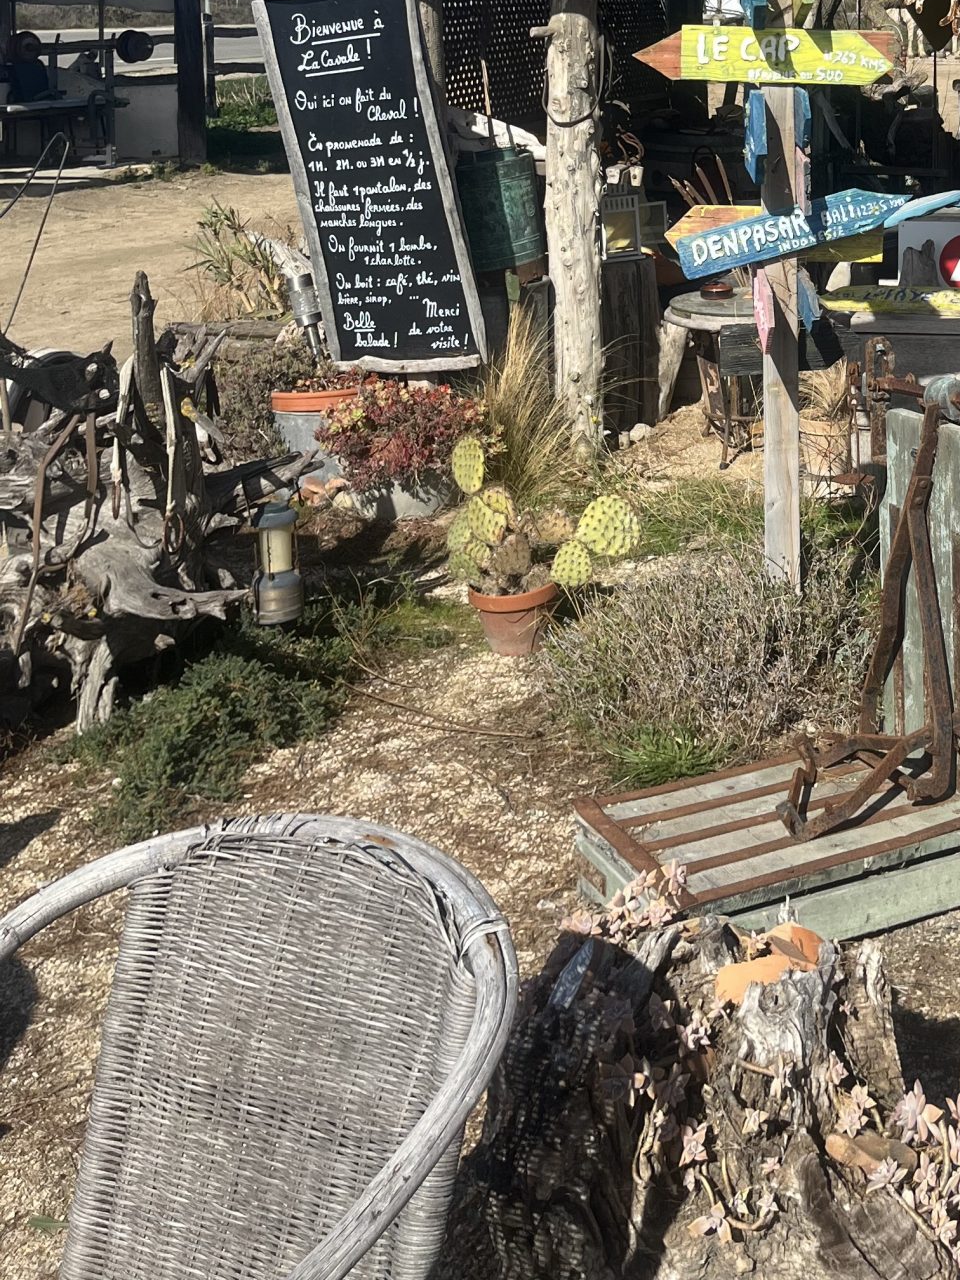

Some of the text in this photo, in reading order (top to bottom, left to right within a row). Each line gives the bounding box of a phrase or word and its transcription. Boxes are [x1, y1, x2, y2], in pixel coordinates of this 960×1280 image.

[290, 10, 384, 44] Bienvenue à
[298, 50, 320, 71] La
[321, 44, 360, 67] Cavale
[697, 31, 800, 65] LE CAP
[816, 68, 844, 81] SUD
[295, 87, 391, 112] Oui ici on fait du
[367, 99, 407, 121] Cheval
[308, 132, 323, 151] En
[326, 133, 383, 157] promenade
[389, 131, 403, 144] de
[356, 160, 367, 168] ou
[389, 157, 401, 165] en
[314, 181, 325, 197] Il
[329, 181, 349, 206] faut
[414, 178, 431, 191] des
[315, 199, 360, 212] chaussures
[406, 197, 423, 210] des
[321, 213, 356, 227] manches
[328, 235, 345, 252] On
[349, 237, 384, 261] fournit
[691, 208, 810, 266] DENPASAR
[336, 273, 351, 289] On
[354, 273, 373, 288] boit
[385, 273, 412, 295] café,
[416, 271, 438, 285] thé,
[423, 298, 460, 318] Merci
[343, 311, 376, 330] Belle
[409, 321, 453, 335] de votre
[355, 332, 390, 347] balade
[431, 335, 459, 349] visite
